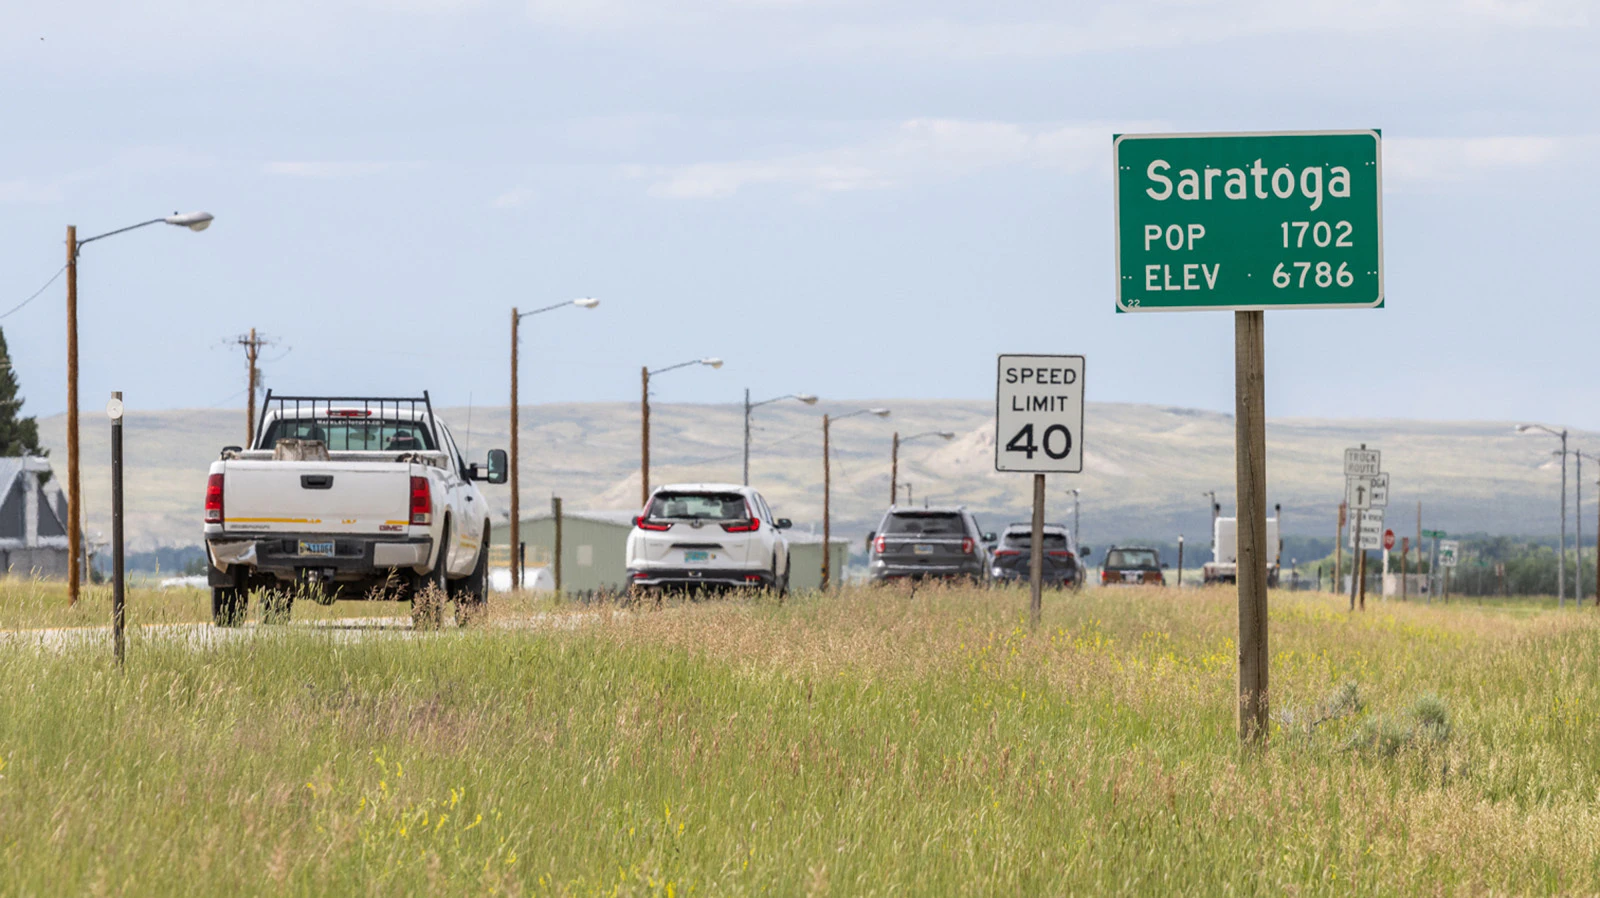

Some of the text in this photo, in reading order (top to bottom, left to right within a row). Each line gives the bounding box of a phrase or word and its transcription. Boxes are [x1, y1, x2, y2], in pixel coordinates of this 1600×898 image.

[1146, 158, 1350, 211] Saratoga
[1145, 221, 1353, 251] POP 1702
[1145, 261, 1354, 291] ELEV 6786
[1006, 367, 1077, 385] SPEED
[1012, 395, 1068, 412] LIMIT
[1005, 423, 1072, 460] 40
[1348, 464, 1376, 474] ROUTE
[1349, 452, 1377, 463] TRUCK
